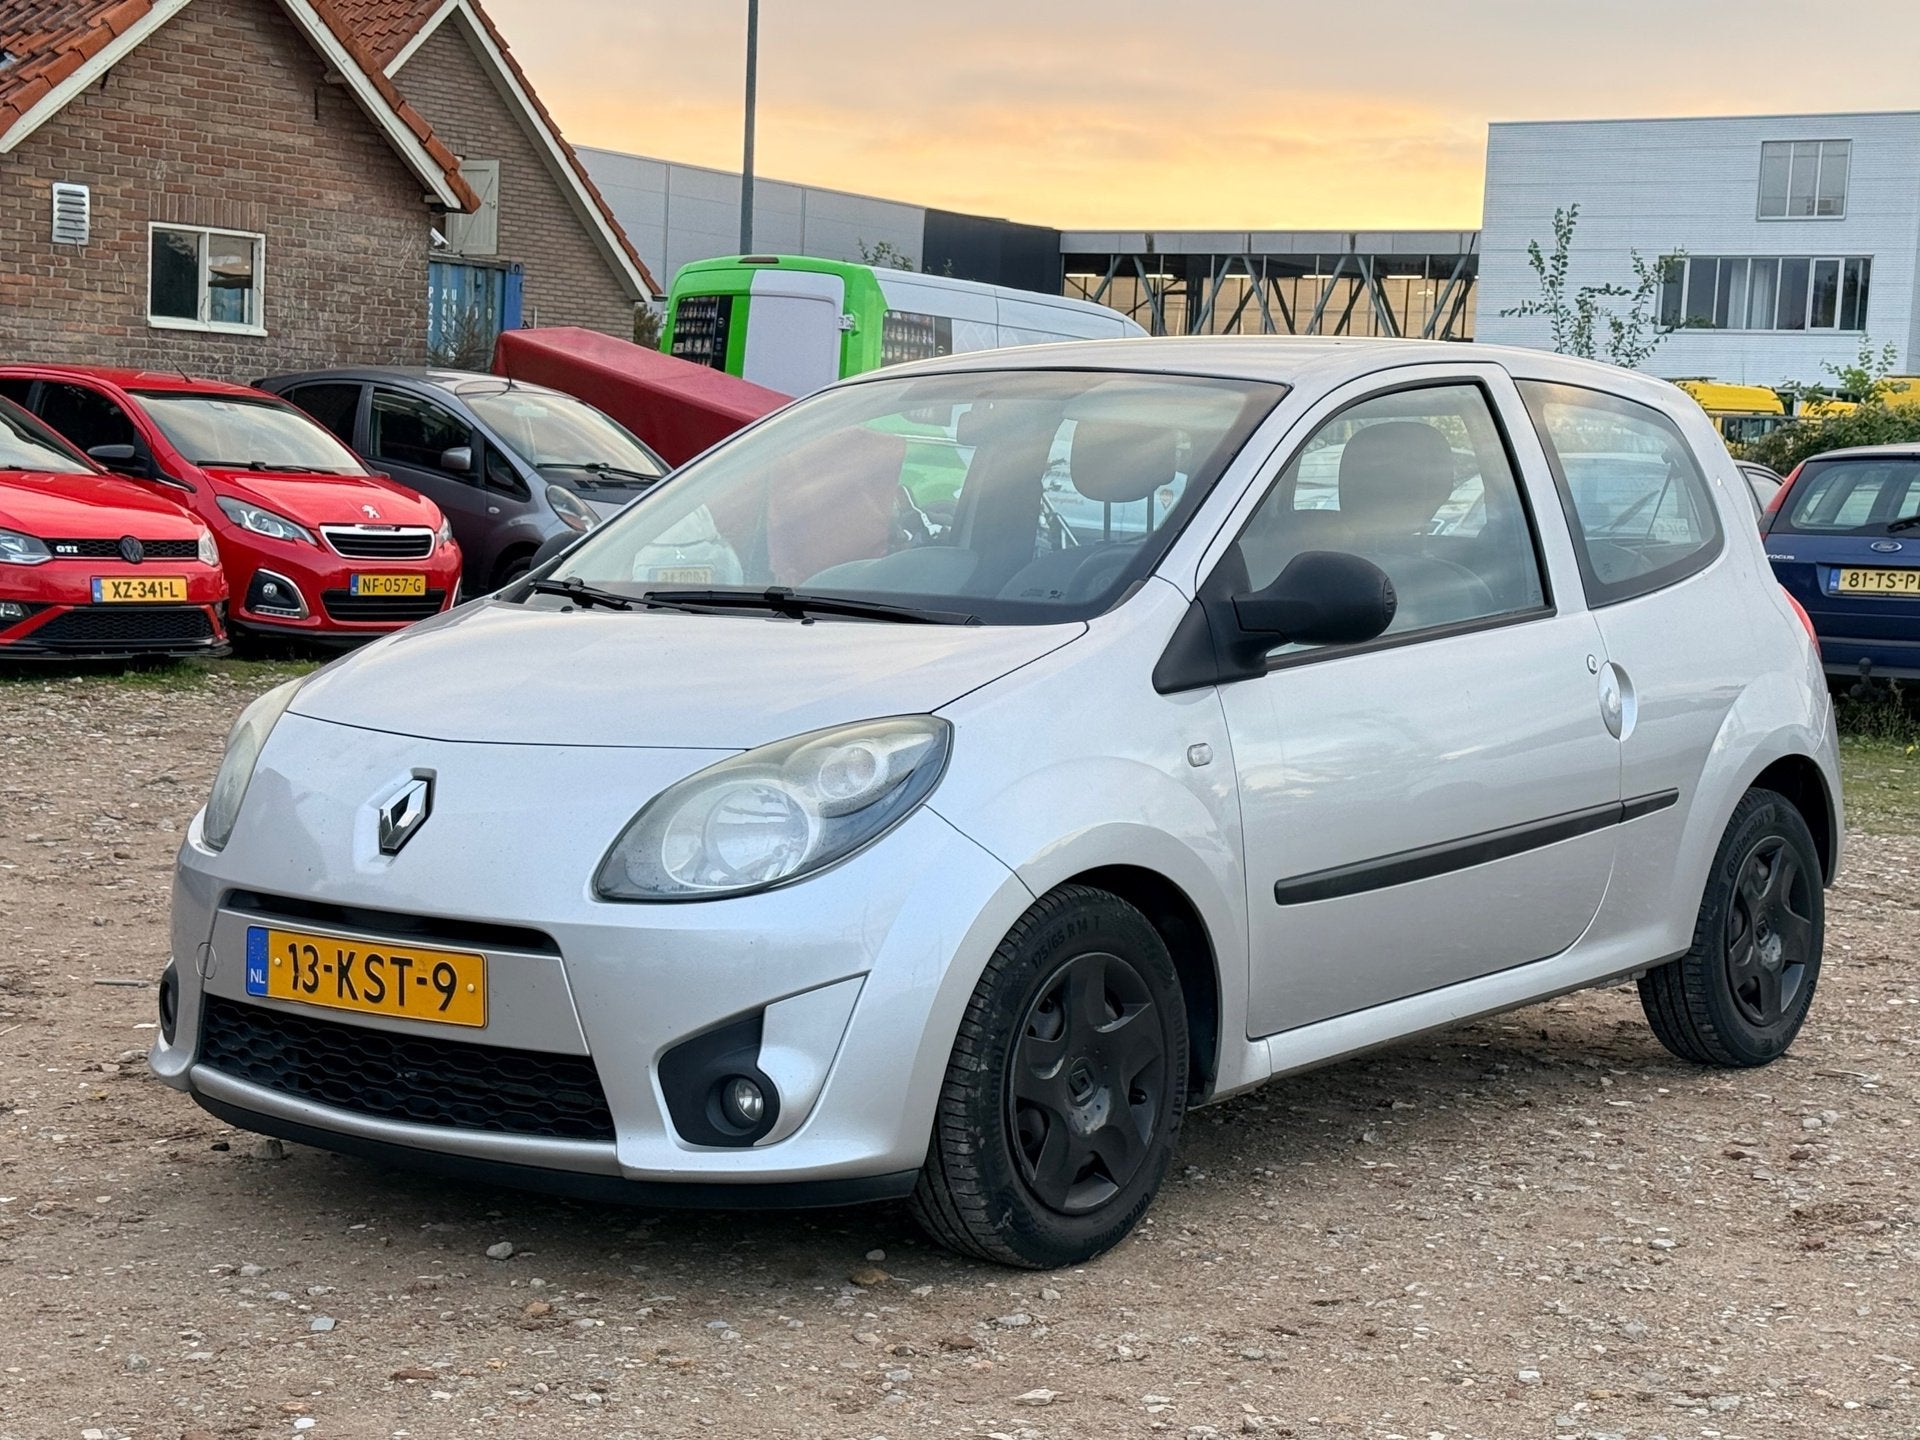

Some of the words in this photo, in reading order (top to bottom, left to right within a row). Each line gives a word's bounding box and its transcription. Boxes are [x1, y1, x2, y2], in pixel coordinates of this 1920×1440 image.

[56, 545, 79, 553] GTI
[111, 581, 179, 599] XZ-341-L
[362, 578, 421, 593] NF-057-G
[1848, 571, 1920, 591] 81-TS-P
[1031, 929, 1065, 968] 175/65
[250, 967, 266, 984] NL
[288, 942, 458, 1012] 13-KST-9
